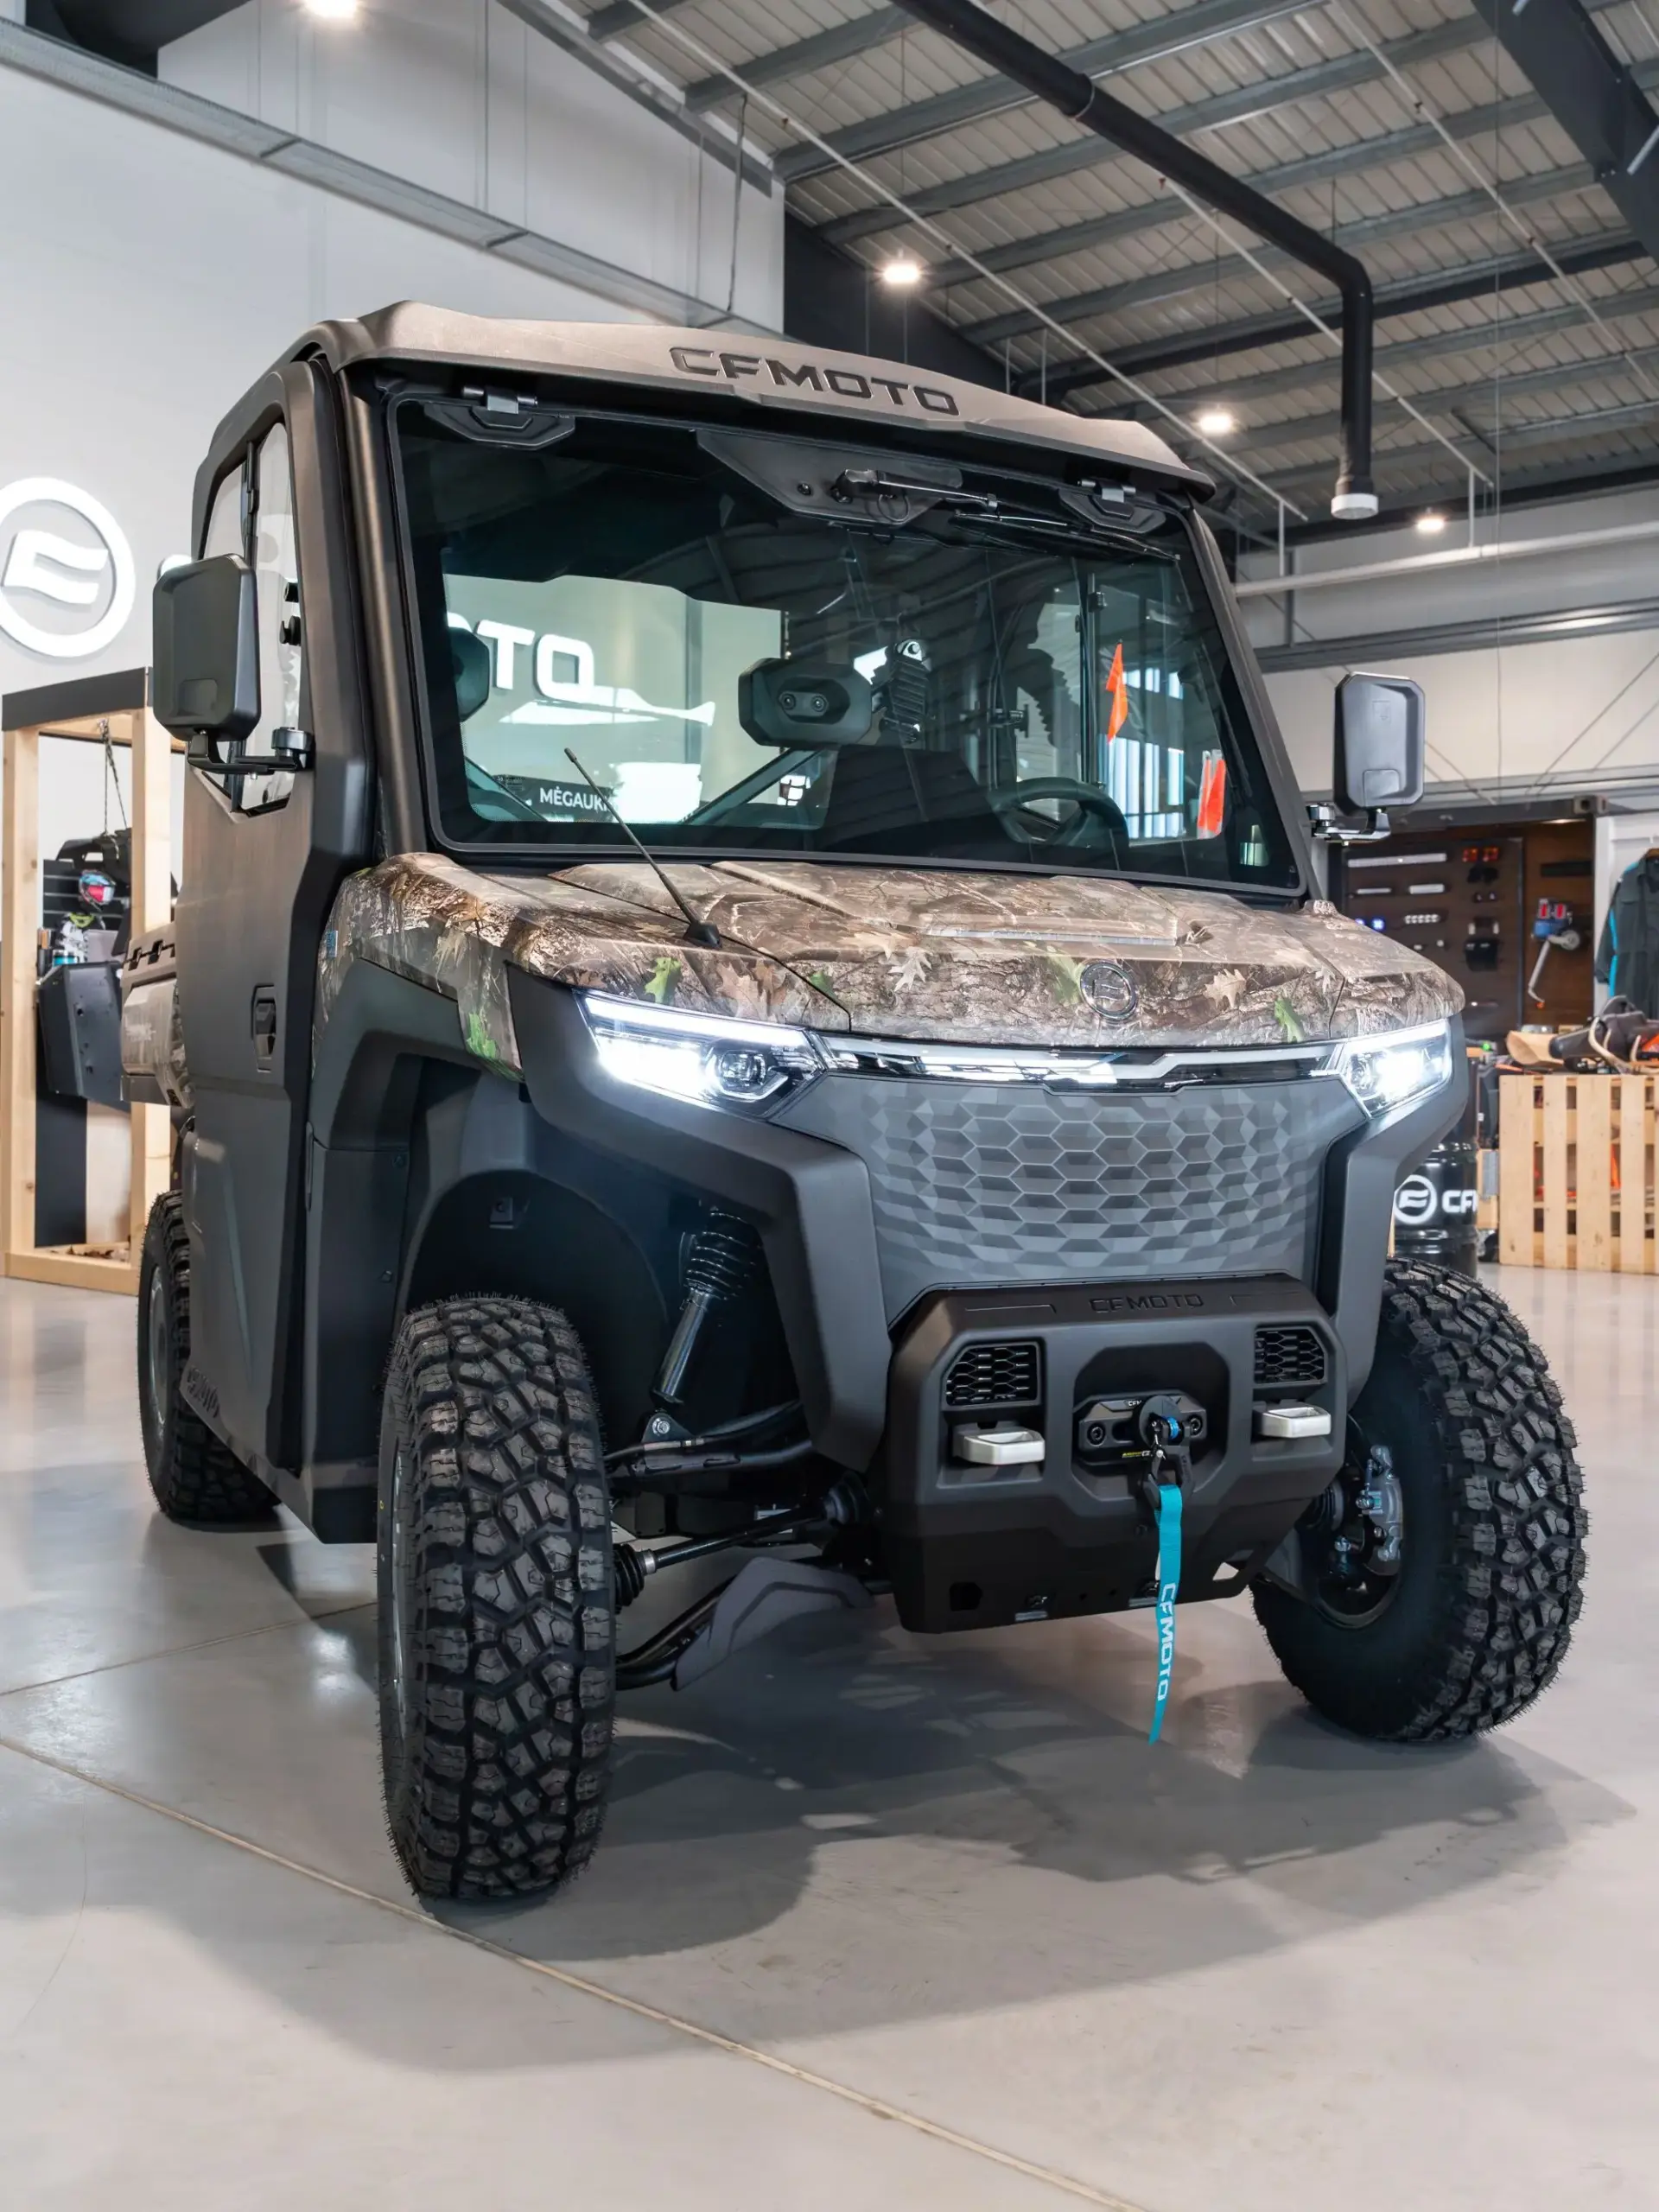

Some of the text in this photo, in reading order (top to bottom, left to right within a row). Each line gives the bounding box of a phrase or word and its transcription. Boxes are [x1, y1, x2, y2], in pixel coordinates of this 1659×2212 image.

[670, 347, 959, 416] CFMOTO
[448, 612, 594, 701] TO
[1089, 1294, 1204, 1313] CFMOTO
[1158, 1583, 1176, 1701] CFMOTO
